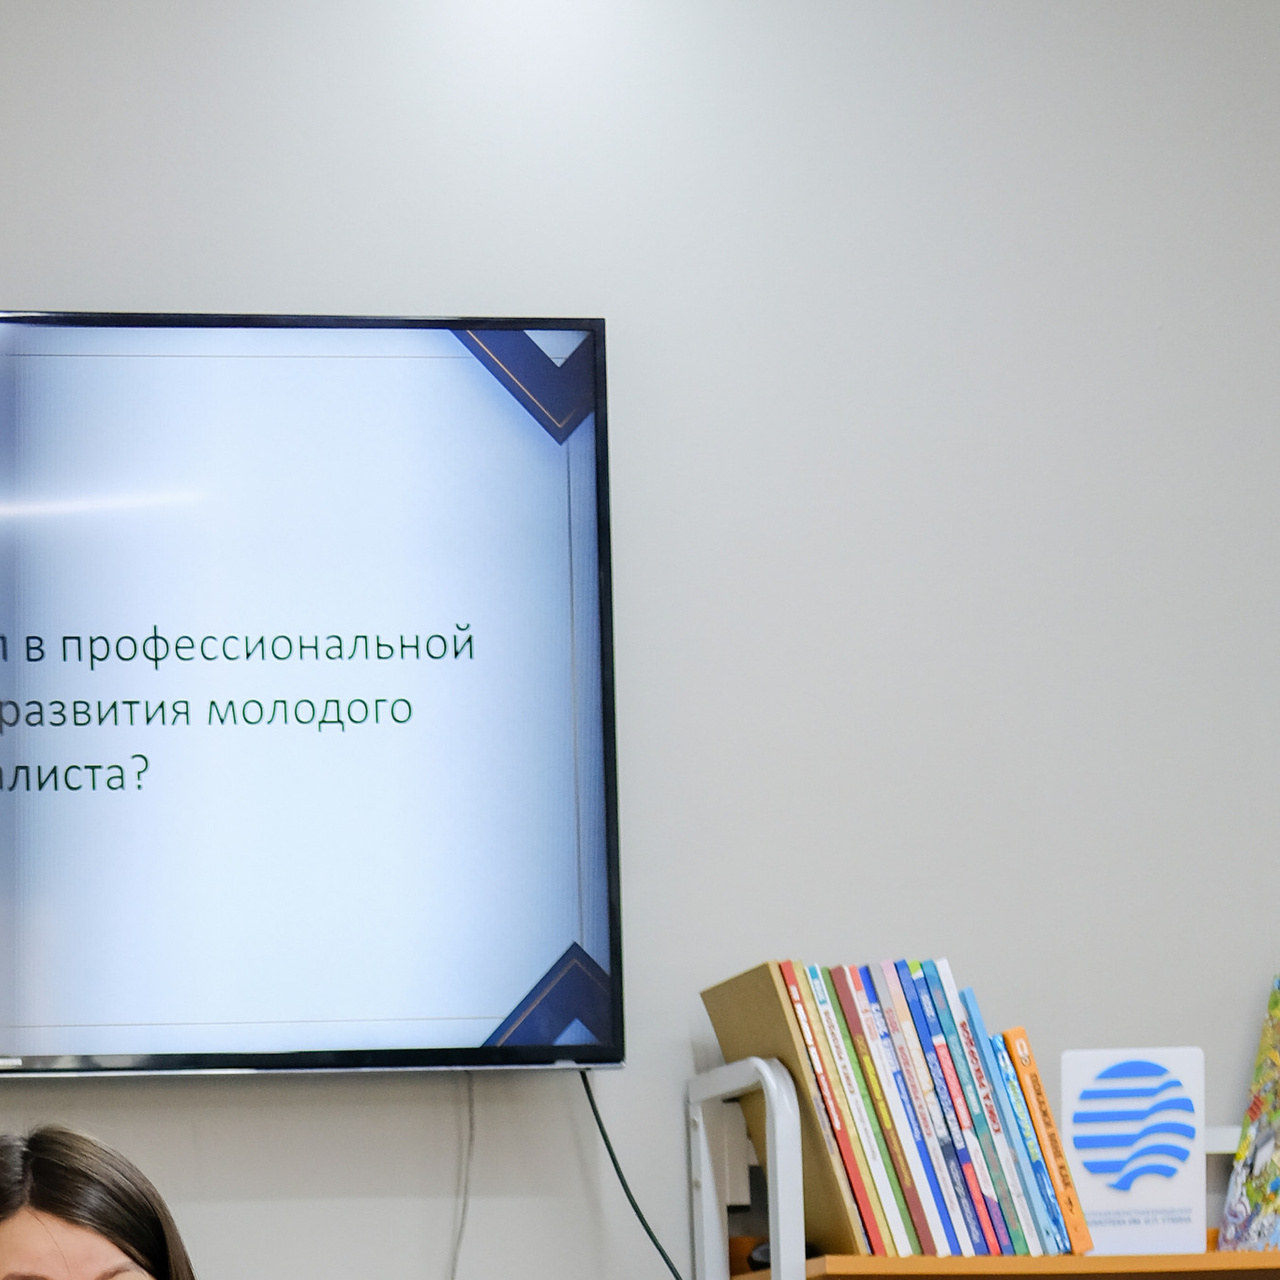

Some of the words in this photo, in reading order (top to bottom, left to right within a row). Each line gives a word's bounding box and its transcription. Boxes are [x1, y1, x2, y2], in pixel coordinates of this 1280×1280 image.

[26, 636, 47, 664] в
[62, 623, 476, 674] профессиональной
[209, 695, 414, 733] молодого
